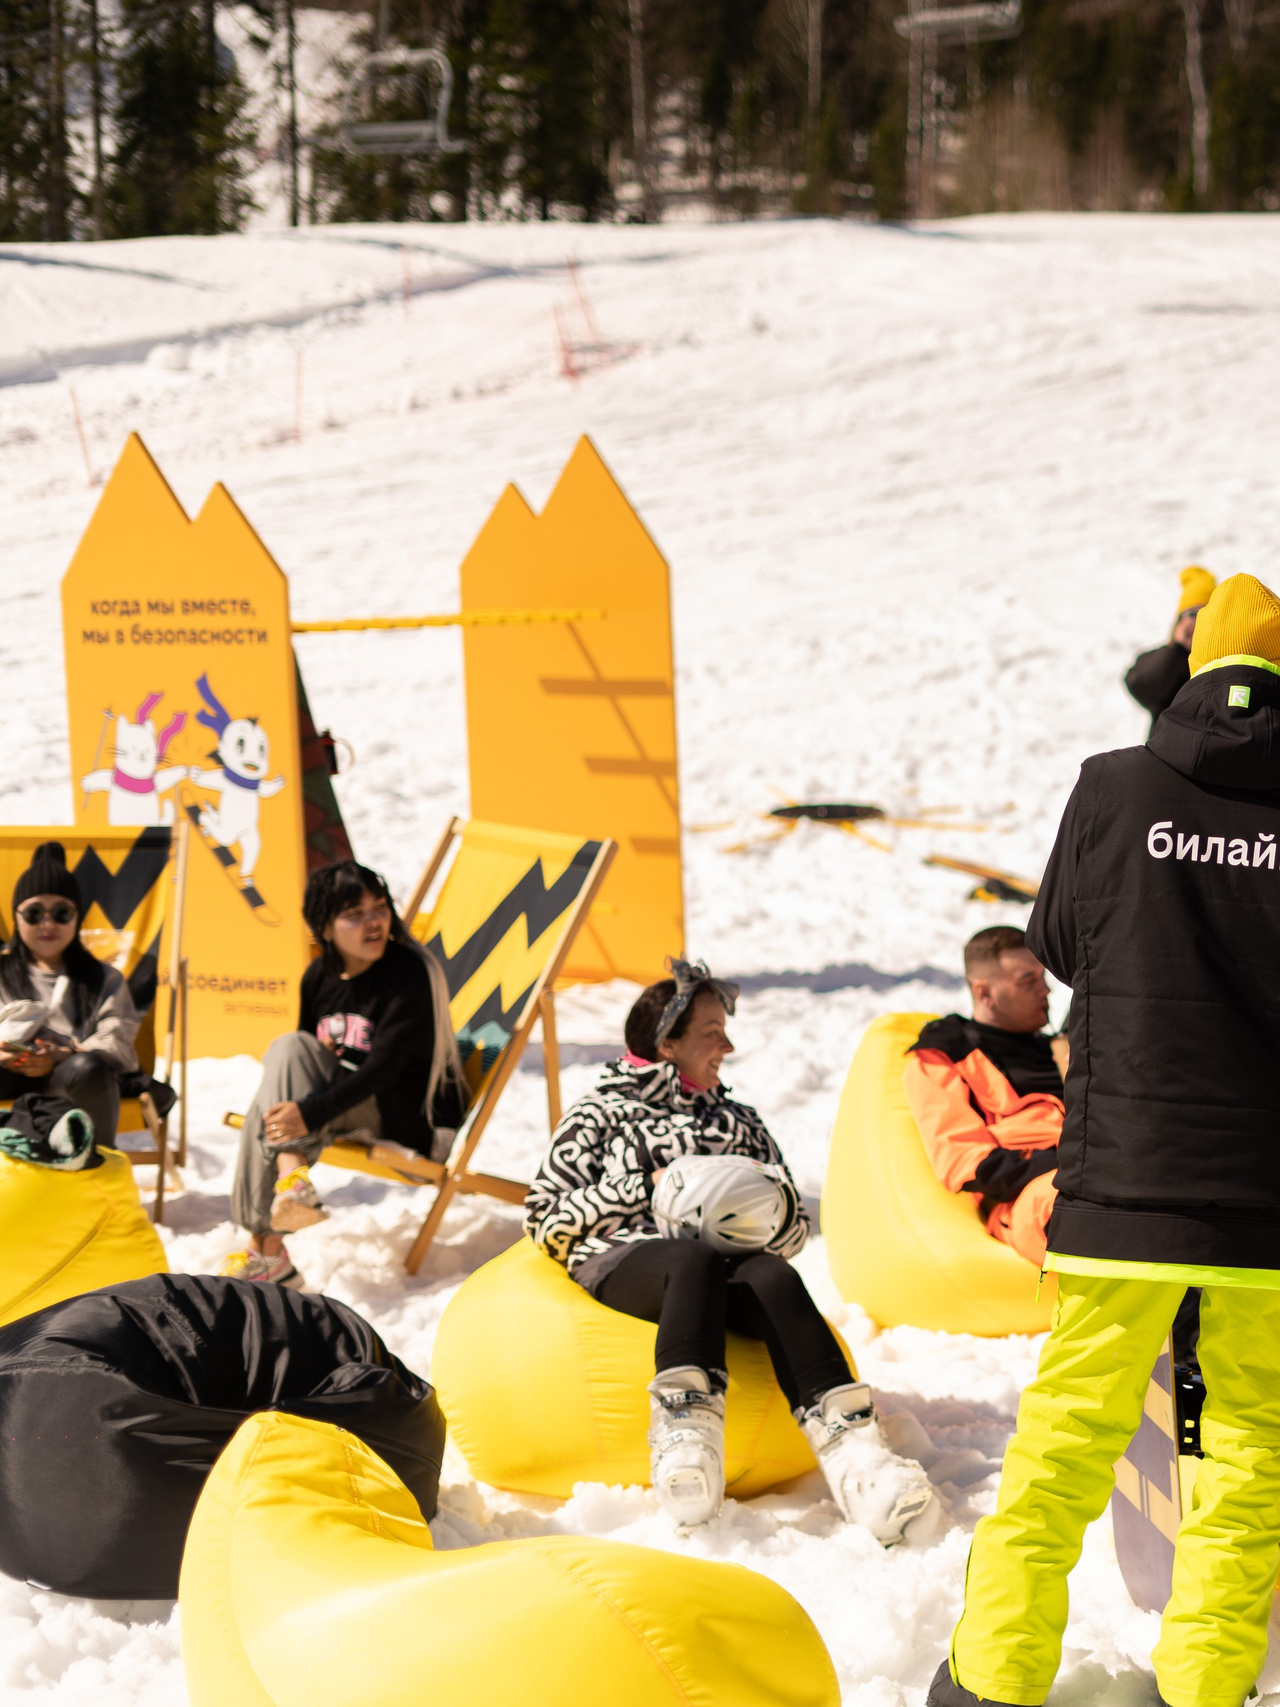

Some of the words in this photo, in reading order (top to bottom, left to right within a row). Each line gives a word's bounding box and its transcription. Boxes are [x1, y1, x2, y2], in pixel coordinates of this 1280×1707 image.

[91, 599, 141, 616] когда
[147, 600, 174, 615] мы
[181, 598, 256, 616] вместе,
[82, 629, 109, 644] мы
[116, 629, 124, 643] в
[131, 624, 268, 644] безопасности
